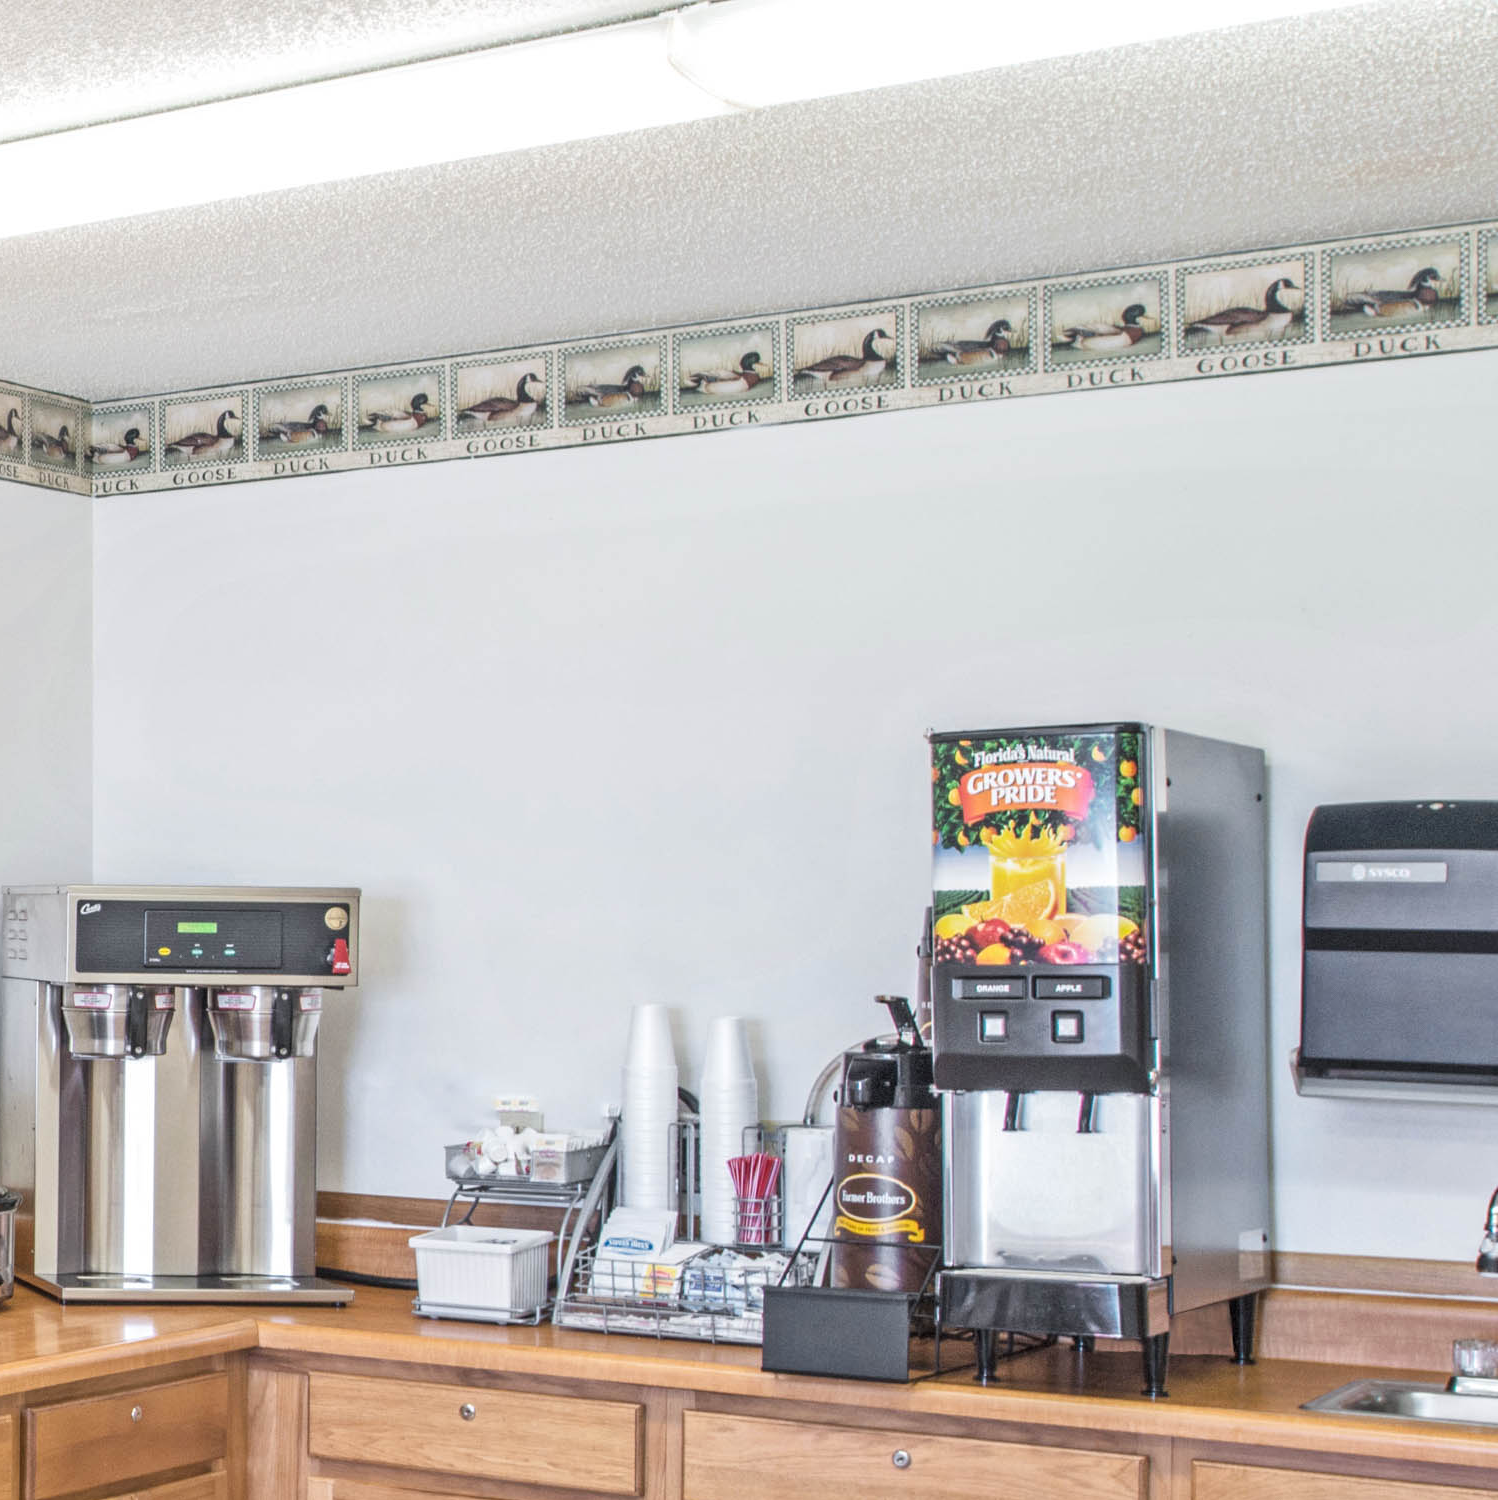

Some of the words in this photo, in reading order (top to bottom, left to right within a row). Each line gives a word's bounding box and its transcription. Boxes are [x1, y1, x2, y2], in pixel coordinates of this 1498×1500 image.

[90, 479, 140, 494] DUCK
[173, 468, 238, 486] GOOSE
[274, 458, 330, 475] DUCK
[369, 448, 429, 465] DUCK
[466, 434, 541, 454] GOOSE
[582, 422, 648, 441] DUCK
[692, 410, 762, 430] DUCK
[804, 395, 891, 417] GOOSE
[939, 380, 1013, 402] DUCK
[1066, 365, 1145, 389] DUCK
[1196, 349, 1298, 374] GOOSE
[1353, 334, 1442, 358] DUCK
[38, 471, 70, 490] DUCK
[972, 745, 1026, 767] Florida's
[1027, 745, 1075, 763] Natural
[990, 786, 1057, 806] PRIDE
[1368, 868, 1411, 877] SYSCO
[976, 984, 1010, 992] ORANGE
[1055, 984, 1082, 992] APPLE
[848, 1154, 895, 1163] DECAF
[866, 1192, 906, 1205] Brothers
